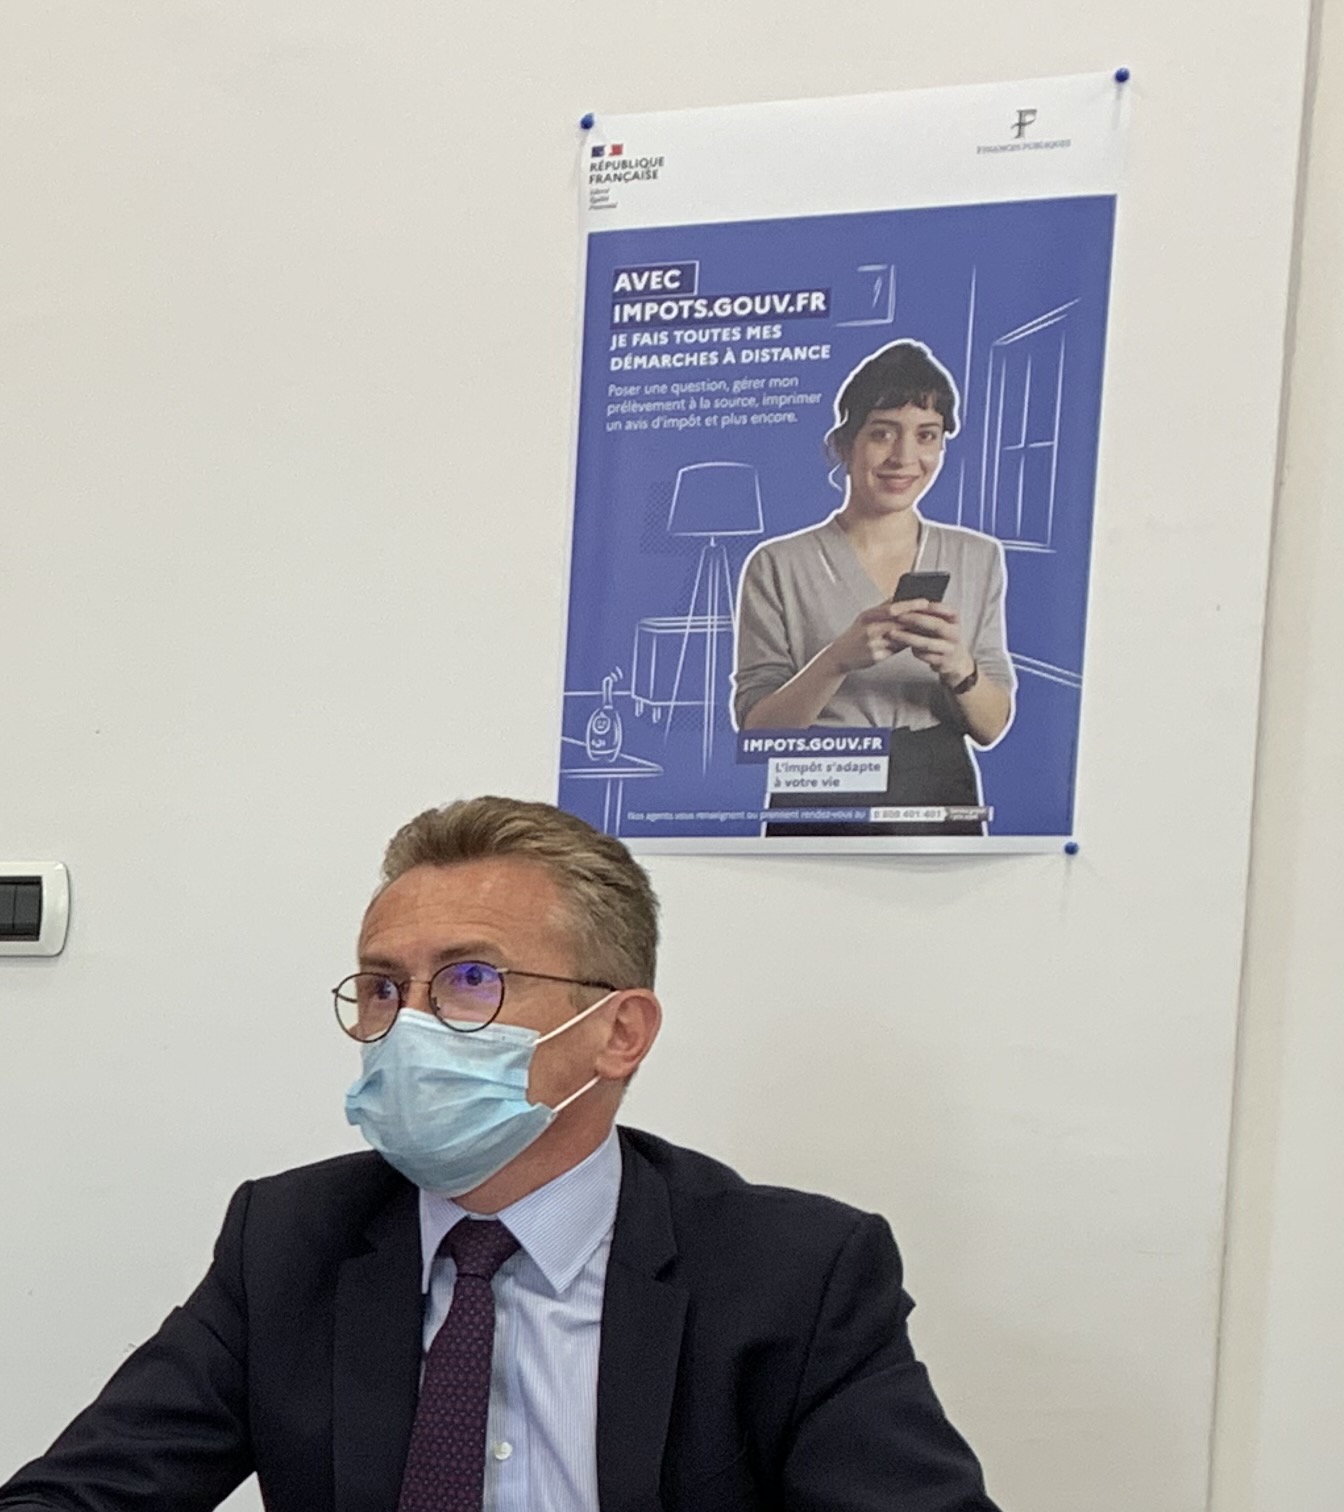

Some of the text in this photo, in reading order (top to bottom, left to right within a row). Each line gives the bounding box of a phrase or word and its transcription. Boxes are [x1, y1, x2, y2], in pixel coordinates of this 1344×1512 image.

[590, 156, 665, 173] RÉPUBLIQUE
[588, 168, 659, 185] FRANÇAISE
[613, 268, 682, 292] AVEC
[613, 290, 827, 324] IMPOTS.GOUV.FR
[609, 323, 783, 351] JE FAIS TOUTES MES
[610, 344, 831, 371] DÉMARCHES À DISTANCE
[607, 376, 800, 398] Poser une question, gérer mon
[606, 392, 823, 417] prélèvement à la source, imprimer
[606, 418, 622, 432] un
[624, 416, 649, 431] avis
[704, 414, 718, 427] et
[721, 412, 749, 429] plus
[743, 737, 884, 753] IMPOTS.GOUV.FR
[785, 777, 818, 788] votre
[822, 776, 841, 788] vie
